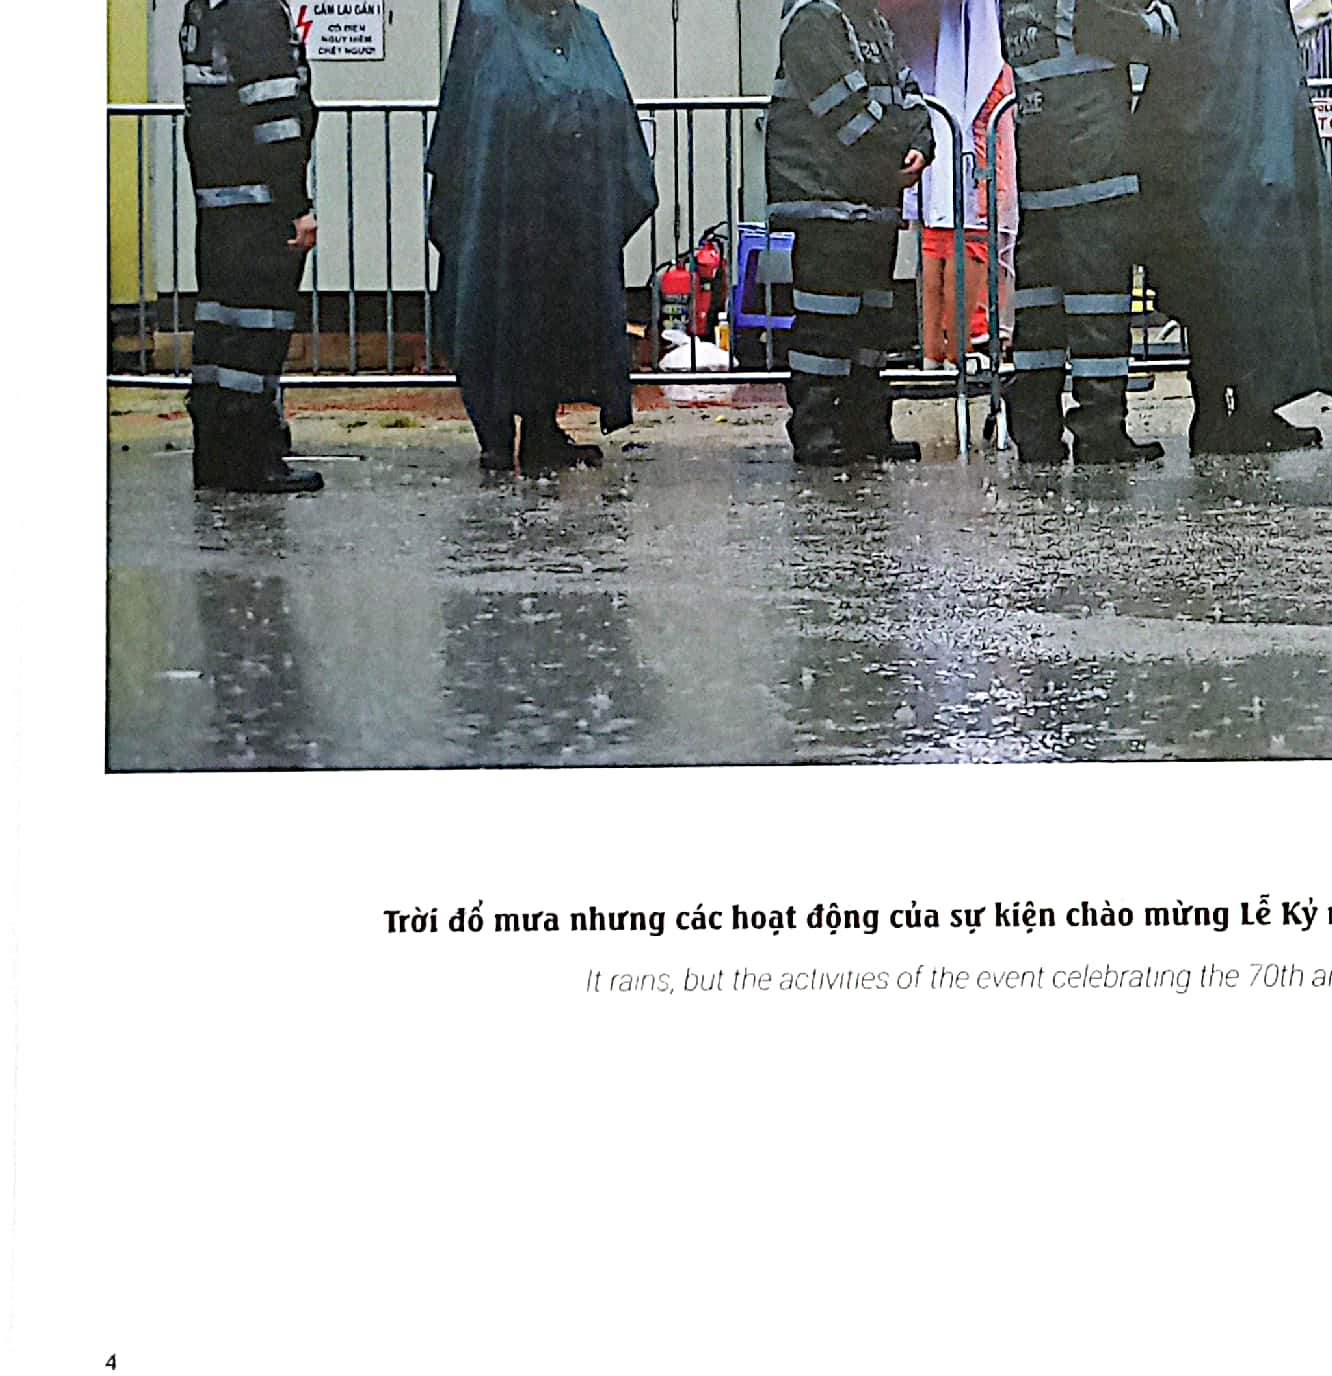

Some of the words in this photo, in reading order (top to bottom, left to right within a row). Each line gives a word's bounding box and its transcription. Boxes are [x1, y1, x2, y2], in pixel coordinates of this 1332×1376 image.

[383, 906, 438, 934] Trời
[448, 898, 484, 933] đổ
[494, 910, 560, 933] mưa
[569, 905, 666, 937] nhưng
[675, 903, 723, 931] các
[731, 903, 797, 937] hoạt
[806, 902, 880, 936] động
[889, 900, 940, 929] của
[949, 906, 986, 935] sự
[994, 900, 1056, 934] kiện
[1065, 899, 1134, 927] chào
[1144, 899, 1229, 933] mừng
[1240, 893, 1272, 926] Lễ
[1281, 896, 1319, 932] Kỷ
[586, 968, 603, 993] It
[609, 972, 675, 996] rains,
[683, 967, 724, 993] but
[732, 967, 773, 992] the
[779, 967, 890, 992] activities
[896, 963, 925, 990] of
[930, 965, 971, 990] the
[976, 966, 1045, 990] event
[1051, 963, 1192, 995] celebrating
[1200, 962, 1240, 989] the
[1249, 962, 1304, 988] 70th
[104, 1352, 117, 1371] 4
